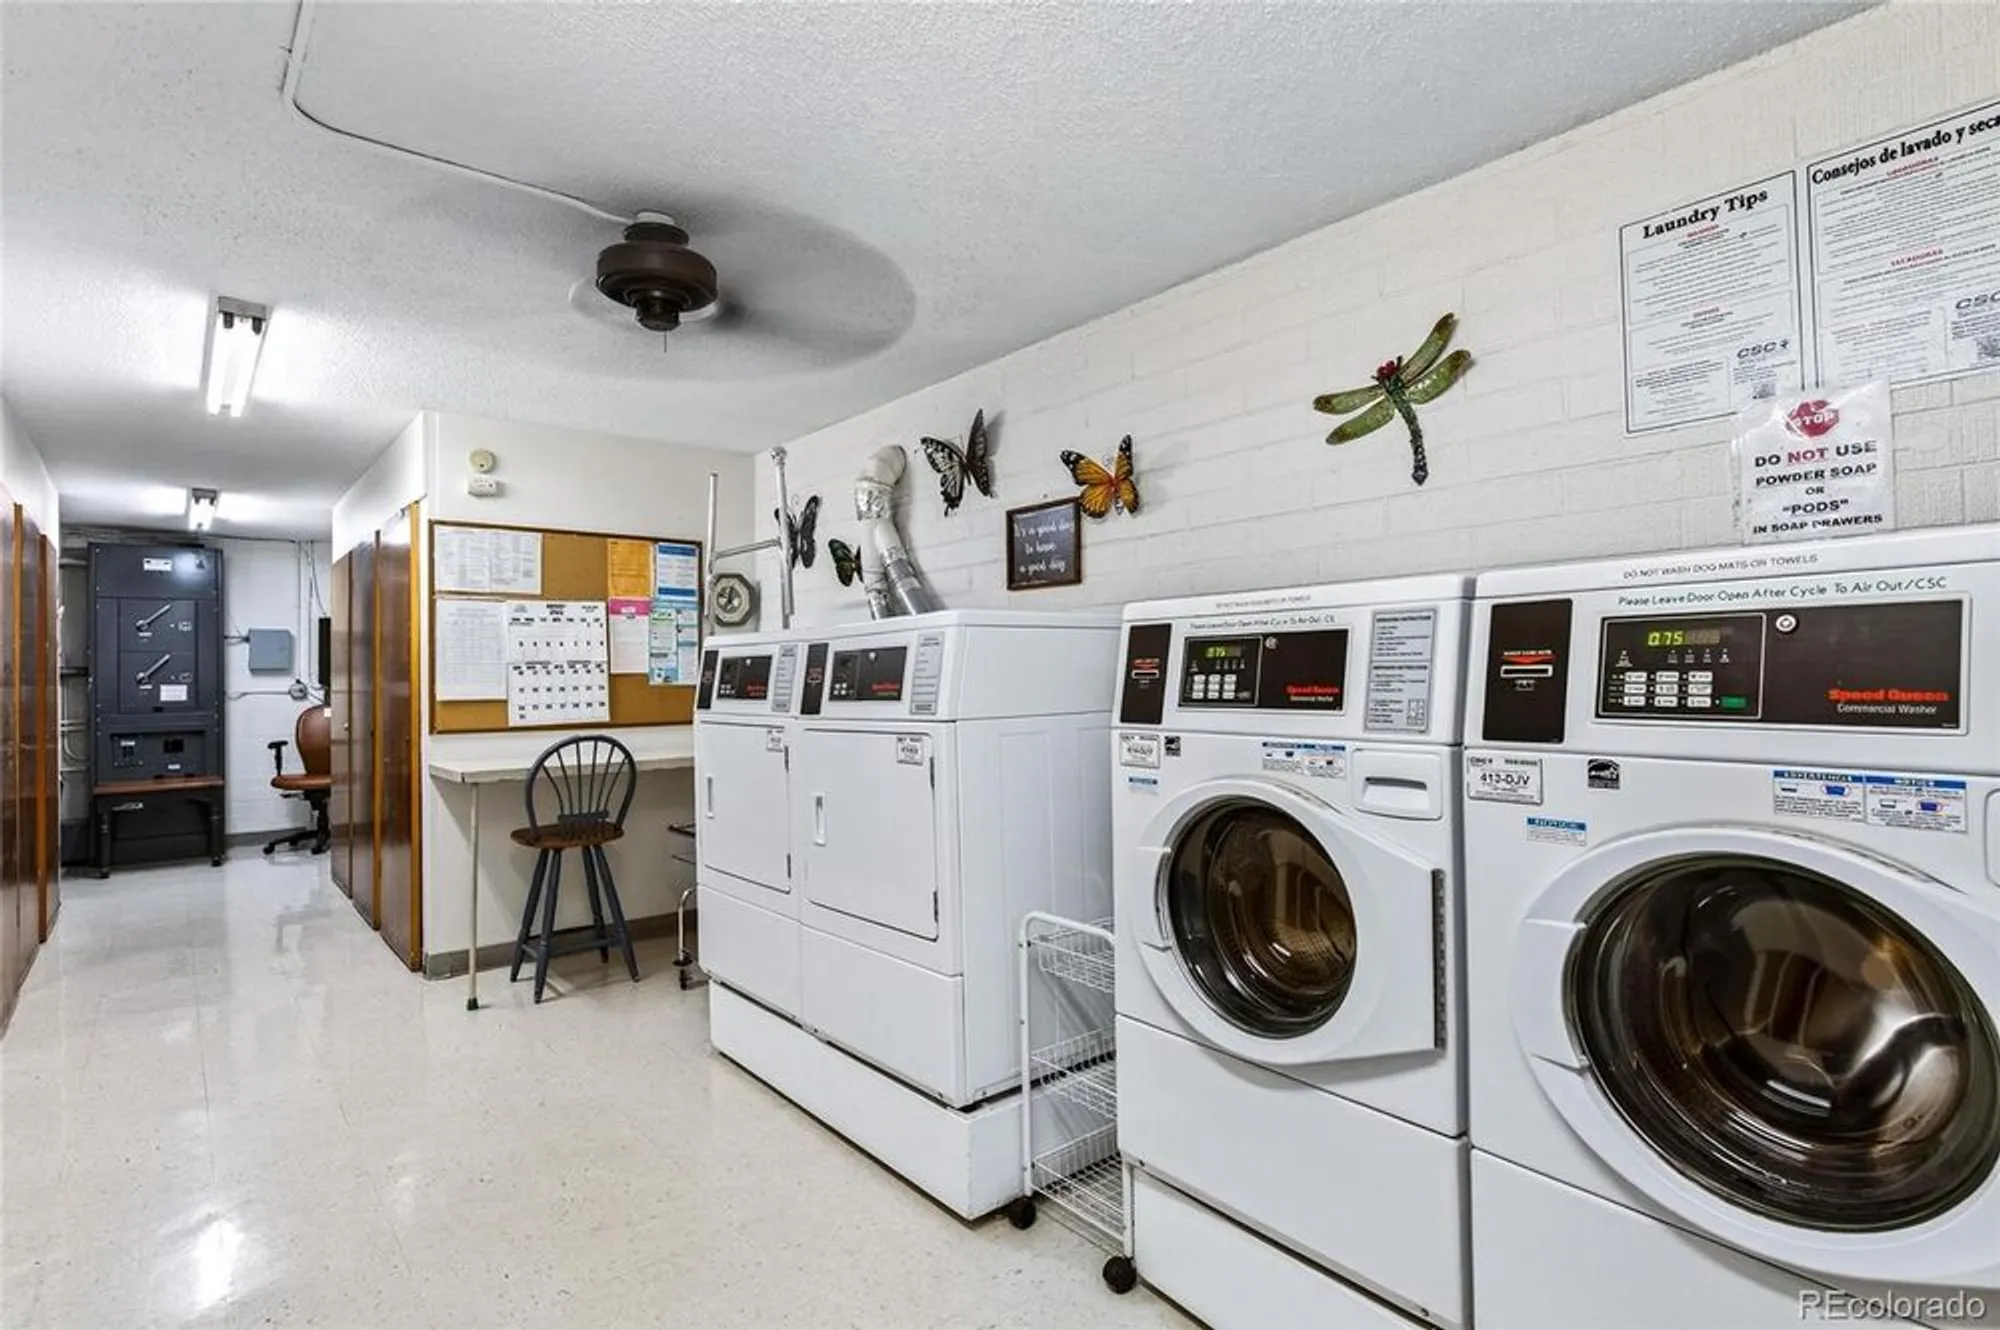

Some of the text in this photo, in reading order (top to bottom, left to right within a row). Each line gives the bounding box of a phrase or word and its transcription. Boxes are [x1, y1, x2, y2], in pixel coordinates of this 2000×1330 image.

[1812, 156, 1877, 185] Consejos
[1879, 147, 1898, 164] de
[1900, 129, 1953, 157] lavado
[1956, 126, 1966, 144] y
[1642, 189, 1769, 239] Laundry Tips
[1754, 440, 1878, 467] DO NOT USE
[1755, 463, 1878, 488] POWDER SOAP
[1805, 486, 1825, 495] OR
[1753, 525, 1767, 535] IN
[1771, 521, 1808, 533] SOAP
[1623, 554, 1818, 579] DO NOT WASH DOG MATS OR TOWELS
[1618, 576, 1949, 607] Please Leave Door Open After Cycle To Air Out/CSC
[1828, 688, 1950, 702] Speed Queen
[1837, 703, 1937, 715] Commercial Washer
